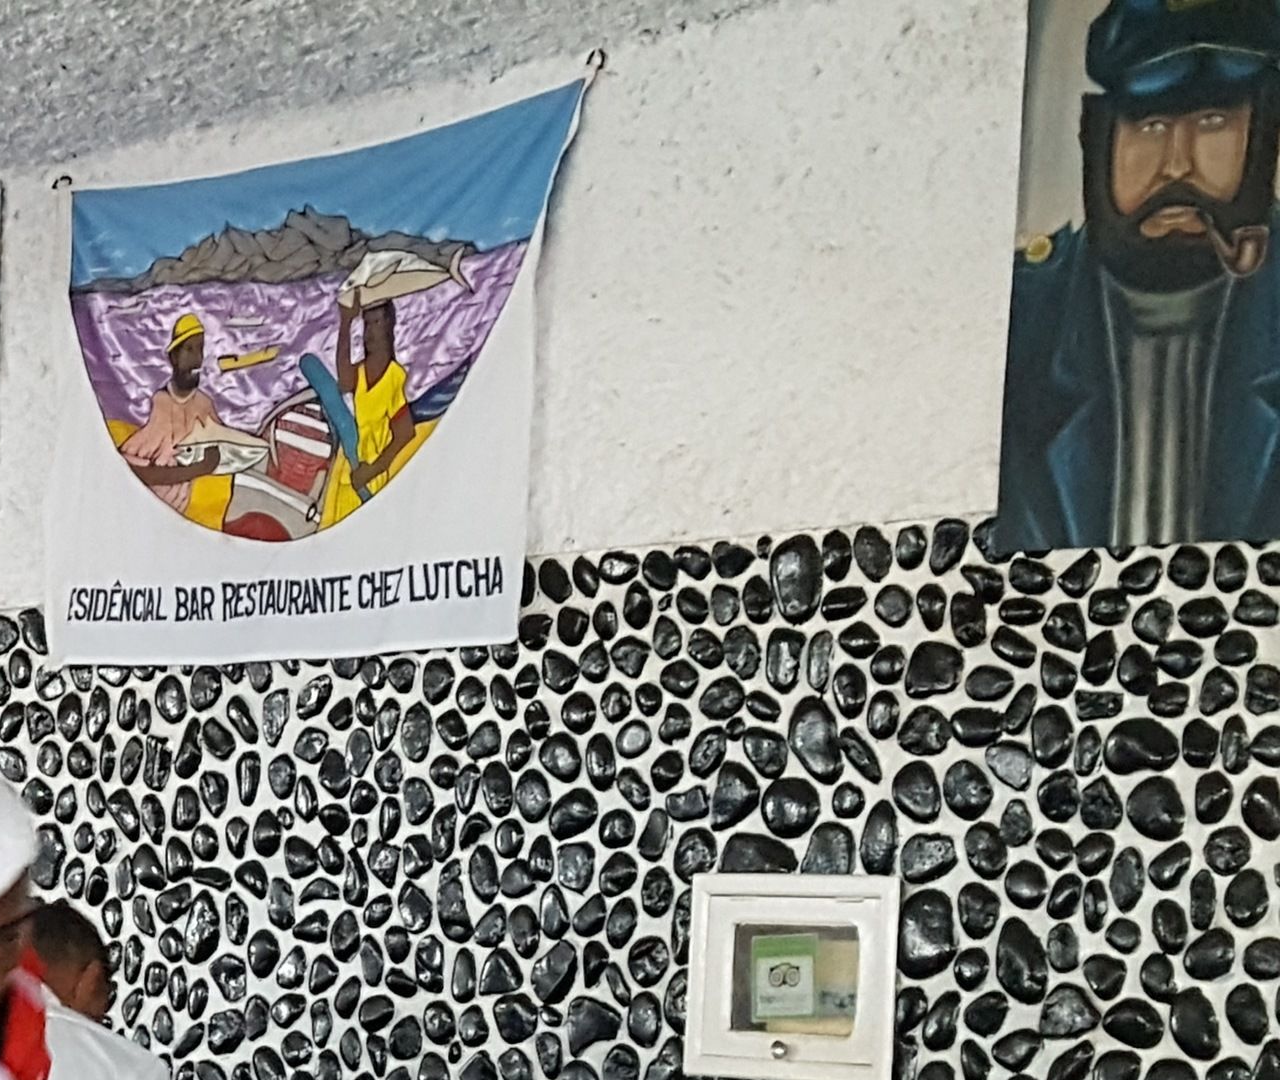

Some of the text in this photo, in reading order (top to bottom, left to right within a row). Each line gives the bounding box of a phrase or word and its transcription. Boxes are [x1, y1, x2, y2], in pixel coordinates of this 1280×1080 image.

[174, 585, 215, 622] BAR
[221, 574, 352, 622] RESTAURANTE
[357, 567, 404, 609] CHEZ
[408, 555, 503, 602] LUTCHA
